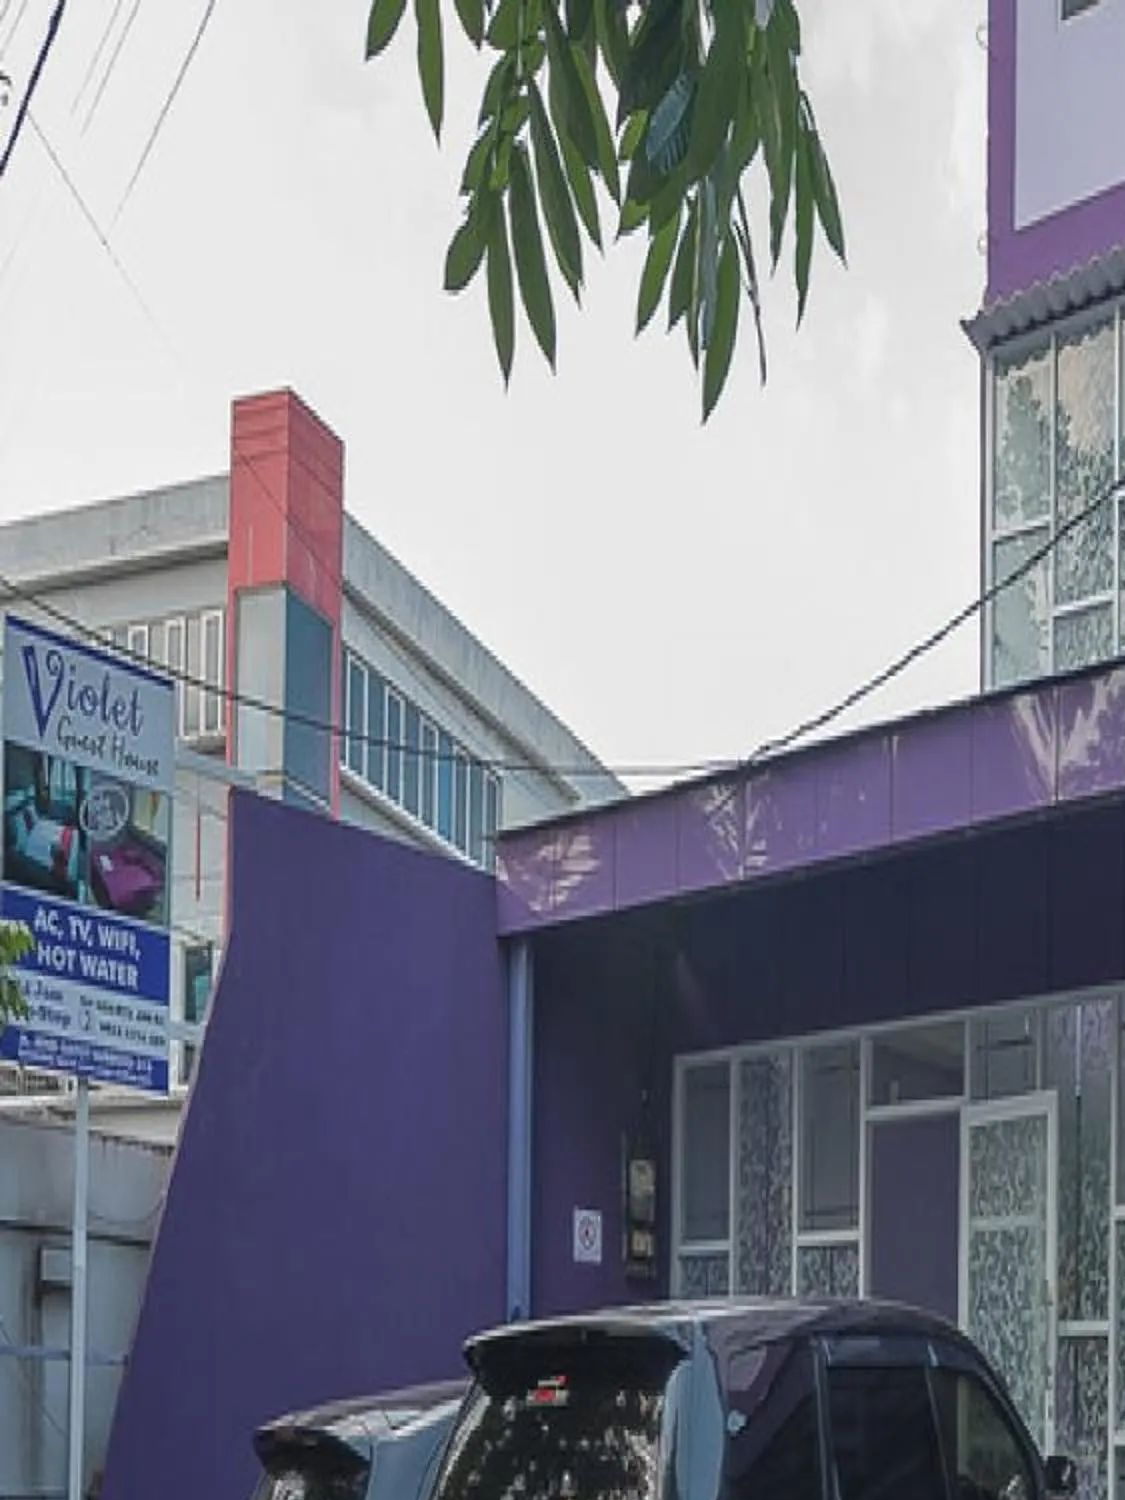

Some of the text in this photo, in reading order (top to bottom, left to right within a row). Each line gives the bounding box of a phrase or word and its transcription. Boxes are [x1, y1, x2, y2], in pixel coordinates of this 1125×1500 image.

[21, 645, 144, 741] Violet
[57, 715, 159, 776] Guest House
[37, 940, 138, 991] HOT WATER
